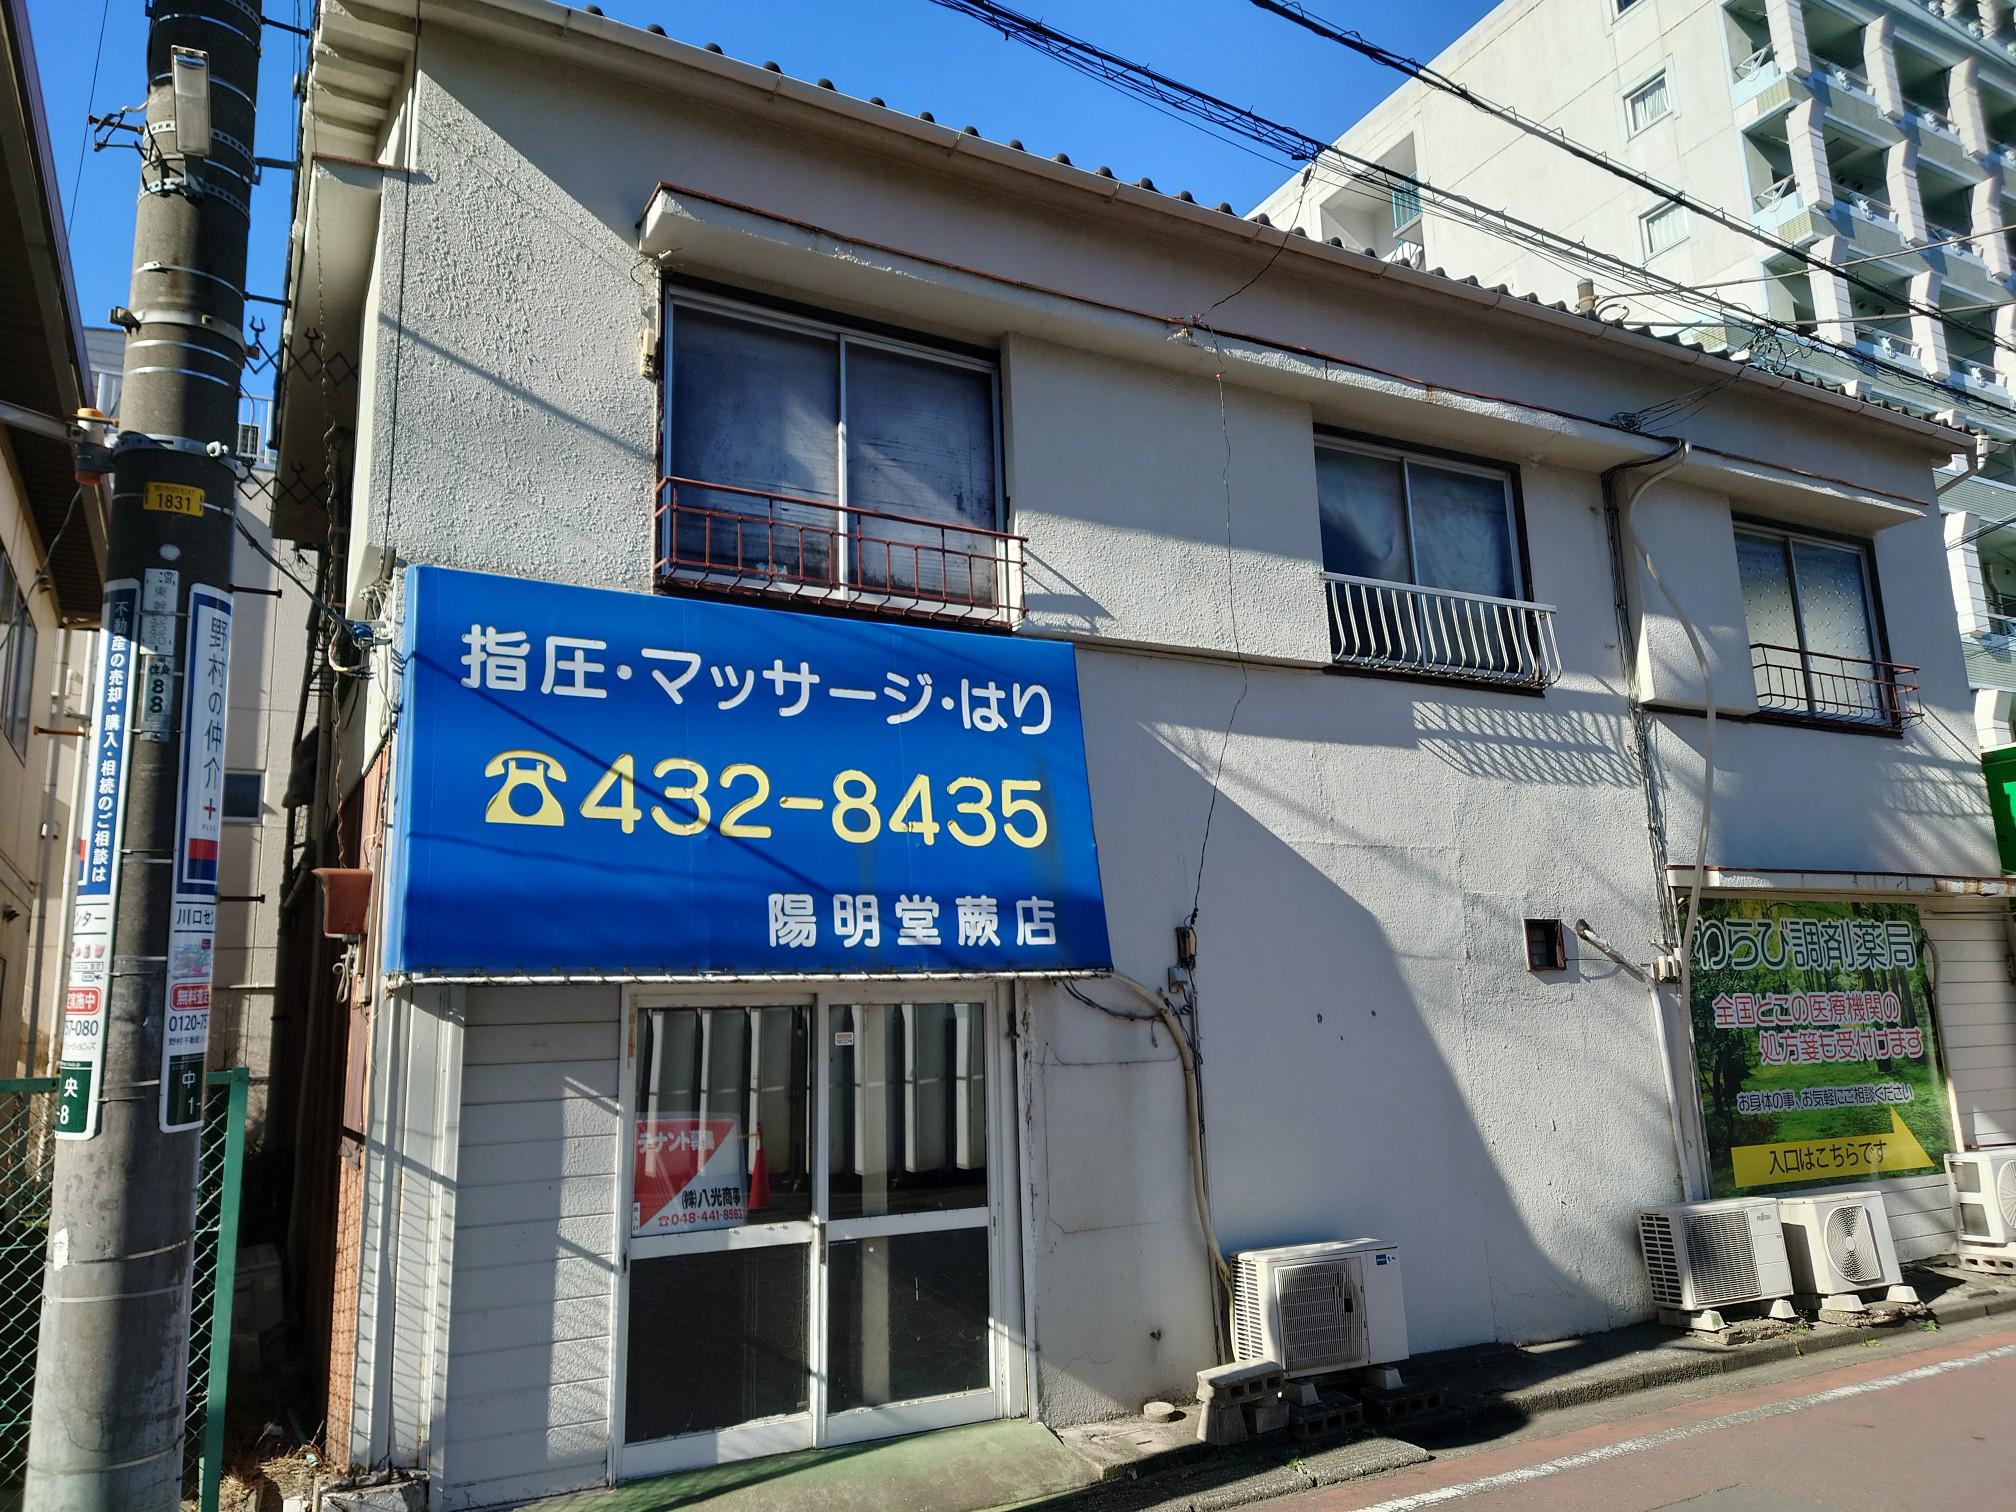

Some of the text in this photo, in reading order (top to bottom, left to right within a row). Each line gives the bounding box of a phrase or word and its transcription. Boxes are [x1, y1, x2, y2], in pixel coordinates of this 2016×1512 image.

[157, 493, 191, 512] 1831
[148, 679, 165, 713] 88
[460, 622, 1053, 736] 指圧・マッサージ・はり
[91, 602, 129, 882] 不動産の売却・購入・相続のご相談は
[579, 752, 1049, 849] 432-8435
[768, 892, 1057, 950] 陽明堂蕨店
[1694, 917, 1918, 972] わらび調剤薬局
[1712, 991, 1901, 1028] 全国どこの医療機関の
[1759, 1027, 1924, 1065] 処方箋も受付けます
[63, 1076, 78, 1098] 央
[182, 1070, 195, 1088] 中
[1737, 1084, 1914, 1114] お身体の事、お気軽にご相談ください
[1769, 1140, 1888, 1176] 入口はこちらです
